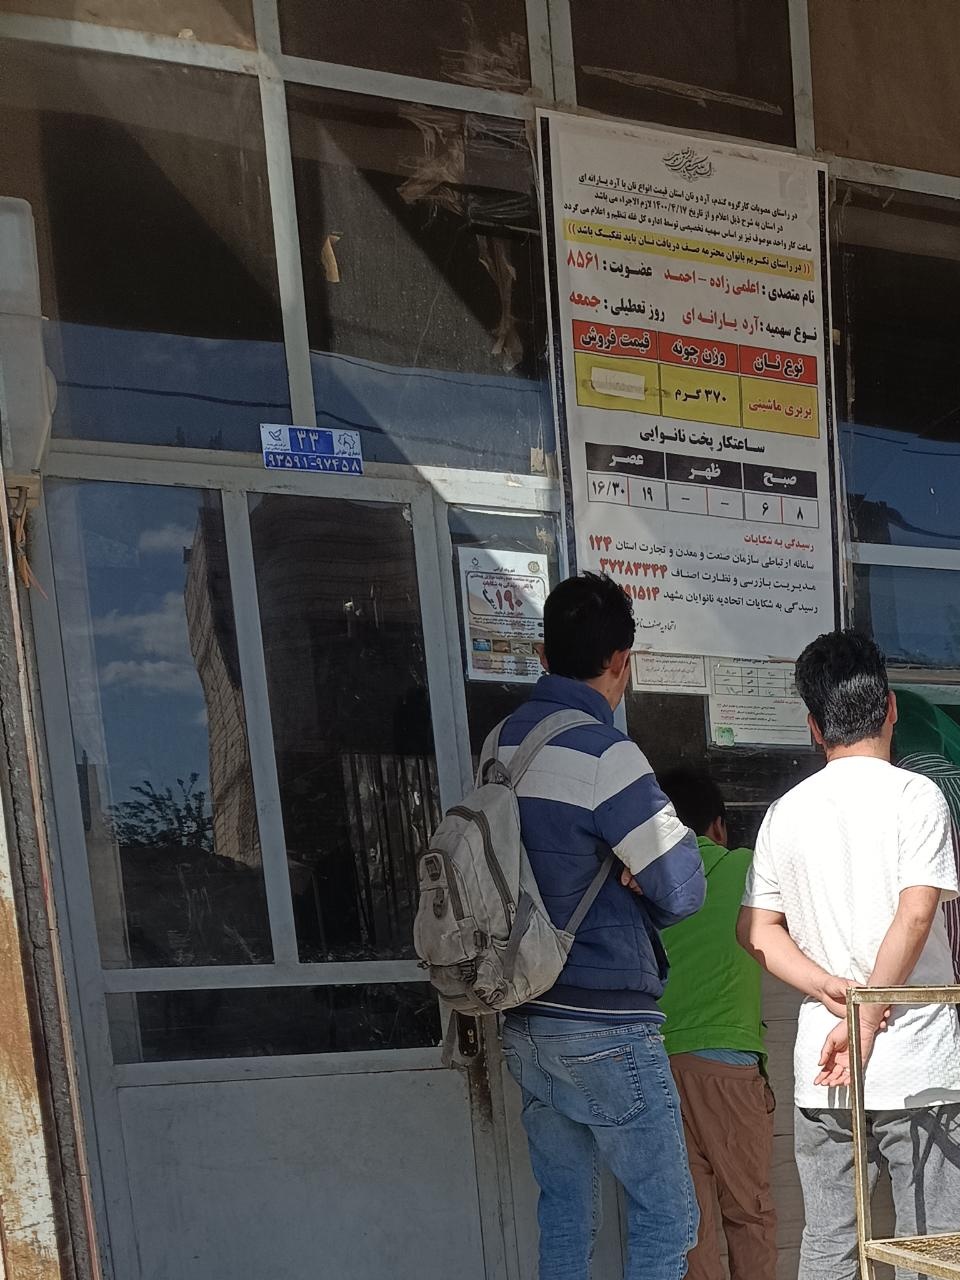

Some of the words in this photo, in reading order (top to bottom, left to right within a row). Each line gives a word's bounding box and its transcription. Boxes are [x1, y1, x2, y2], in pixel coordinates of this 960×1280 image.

[578, 173, 588, 183] ای
[589, 174, 609, 186] یارانه
[609, 177, 620, 189] آرد
[621, 179, 627, 190] با
[627, 181, 637, 191] نان
[637, 183, 653, 194] انواع
[594, 191, 608, 201] باشد
[653, 185, 668, 198] قیمت
[668, 188, 684, 199] استان
[684, 191, 695, 202] نان
[608, 196, 619, 204] می
[641, 199, 653, 210] لازم
[700, 193, 710, 205] آرد
[563, 202, 579, 213] گردد
[579, 206, 591, 215] می
[590, 206, 606, 217] اعلام
[688, 208, 704, 219] تاریخ
[750, 204, 771, 215] مصوبات
[611, 209, 627, 220] تنظیم
[628, 211, 638, 220] غله
[637, 214, 648, 224] کل
[704, 211, 710, 220] از
[715, 212, 730, 222] اعلام
[730, 215, 741, 225] ذیل
[770, 208, 791, 220] راستای
[791, 212, 798, 222] در
[647, 216, 663, 227] اداره
[663, 219, 680, 230] توسط
[741, 218, 753, 228] شرح
[754, 219, 760, 228] به
[760, 221, 777, 231] استان
[576, 225, 594, 239] باشد
[679, 223, 704, 233] تخصیصی
[704, 227, 721, 237] سهمیه
[776, 224, 785, 233] در
[594, 228, 622, 242] تفکیک
[623, 232, 637, 243] باید
[638, 235, 655, 246] نان
[738, 233, 744, 242] بر
[744, 233, 752, 243] نیز
[752, 235, 772, 246] موصوف
[655, 238, 681, 250] دریافت
[773, 239, 786, 250] واحد
[788, 241, 797, 250] کار
[797, 242, 812, 252] ساعت
[702, 247, 726, 259] محترمه
[726, 250, 747, 262] بانوان
[566, 249, 599, 272] ۸۵۶۱
[746, 255, 770, 266] تکریم
[769, 259, 794, 272] راستای
[794, 263, 802, 273] در
[664, 268, 696, 285] احمد
[709, 274, 731, 294] زاده
[732, 279, 760, 296] اعلمی
[568, 290, 602, 313] جمعه
[802, 290, 816, 307] نام
[647, 303, 666, 323] روز
[682, 306, 696, 326] ای
[697, 309, 739, 332] یارانه
[741, 315, 760, 336] آرد
[579, 325, 618, 350] فروش
[793, 326, 818, 344] نوع
[618, 330, 652, 354] قیمت
[671, 338, 700, 364] چونه
[701, 347, 728, 369] وزن
[752, 352, 783, 374] نان
[783, 356, 806, 379] نوع
[674, 387, 702, 403] گرم
[704, 388, 728, 405] ۳۷۰
[748, 399, 783, 415] ماشینی
[784, 405, 813, 421] بربری
[639, 424, 688, 444] نانوایی
[297, 429, 320, 452] ۳۳
[688, 431, 714, 452] پخت
[608, 454, 645, 468] عصر
[687, 462, 722, 482] ظهر
[762, 471, 798, 489] صبح
[591, 480, 626, 497] ۱۶/۳۰
[642, 486, 655, 502] ۱۹
[761, 501, 770, 517] ۶
[796, 506, 805, 521] ۸
[615, 540, 638, 551] استان
[743, 533, 774, 547] شکایات
[774, 536, 784, 548] به
[784, 538, 815, 553] رسیدگی
[639, 543, 667, 557] تجارت
[669, 547, 675, 558] و
[675, 547, 698, 558] معدن
[699, 551, 706, 561] و
[706, 550, 731, 562] صنعت
[732, 553, 760, 566] سازمان
[761, 556, 792, 569] ارتباطی
[793, 558, 815, 570] سامانه
[670, 567, 701, 580] اصناف
[701, 571, 732, 584] نظارت
[733, 576, 739, 587] و
[740, 577, 772, 590] بازرسی
[773, 580, 817, 593] مدیریت
[623, 583, 661, 602] ۹۱۵۱۴
[663, 589, 685, 603] مشهد
[495, 589, 524, 612] ۱۹۰
[685, 592, 716, 606] نانوایان
[716, 596, 745, 607] اتحادیه
[745, 598, 774, 611] شکایات
[775, 602, 784, 613] به
[784, 601, 819, 615] رسیدگی
